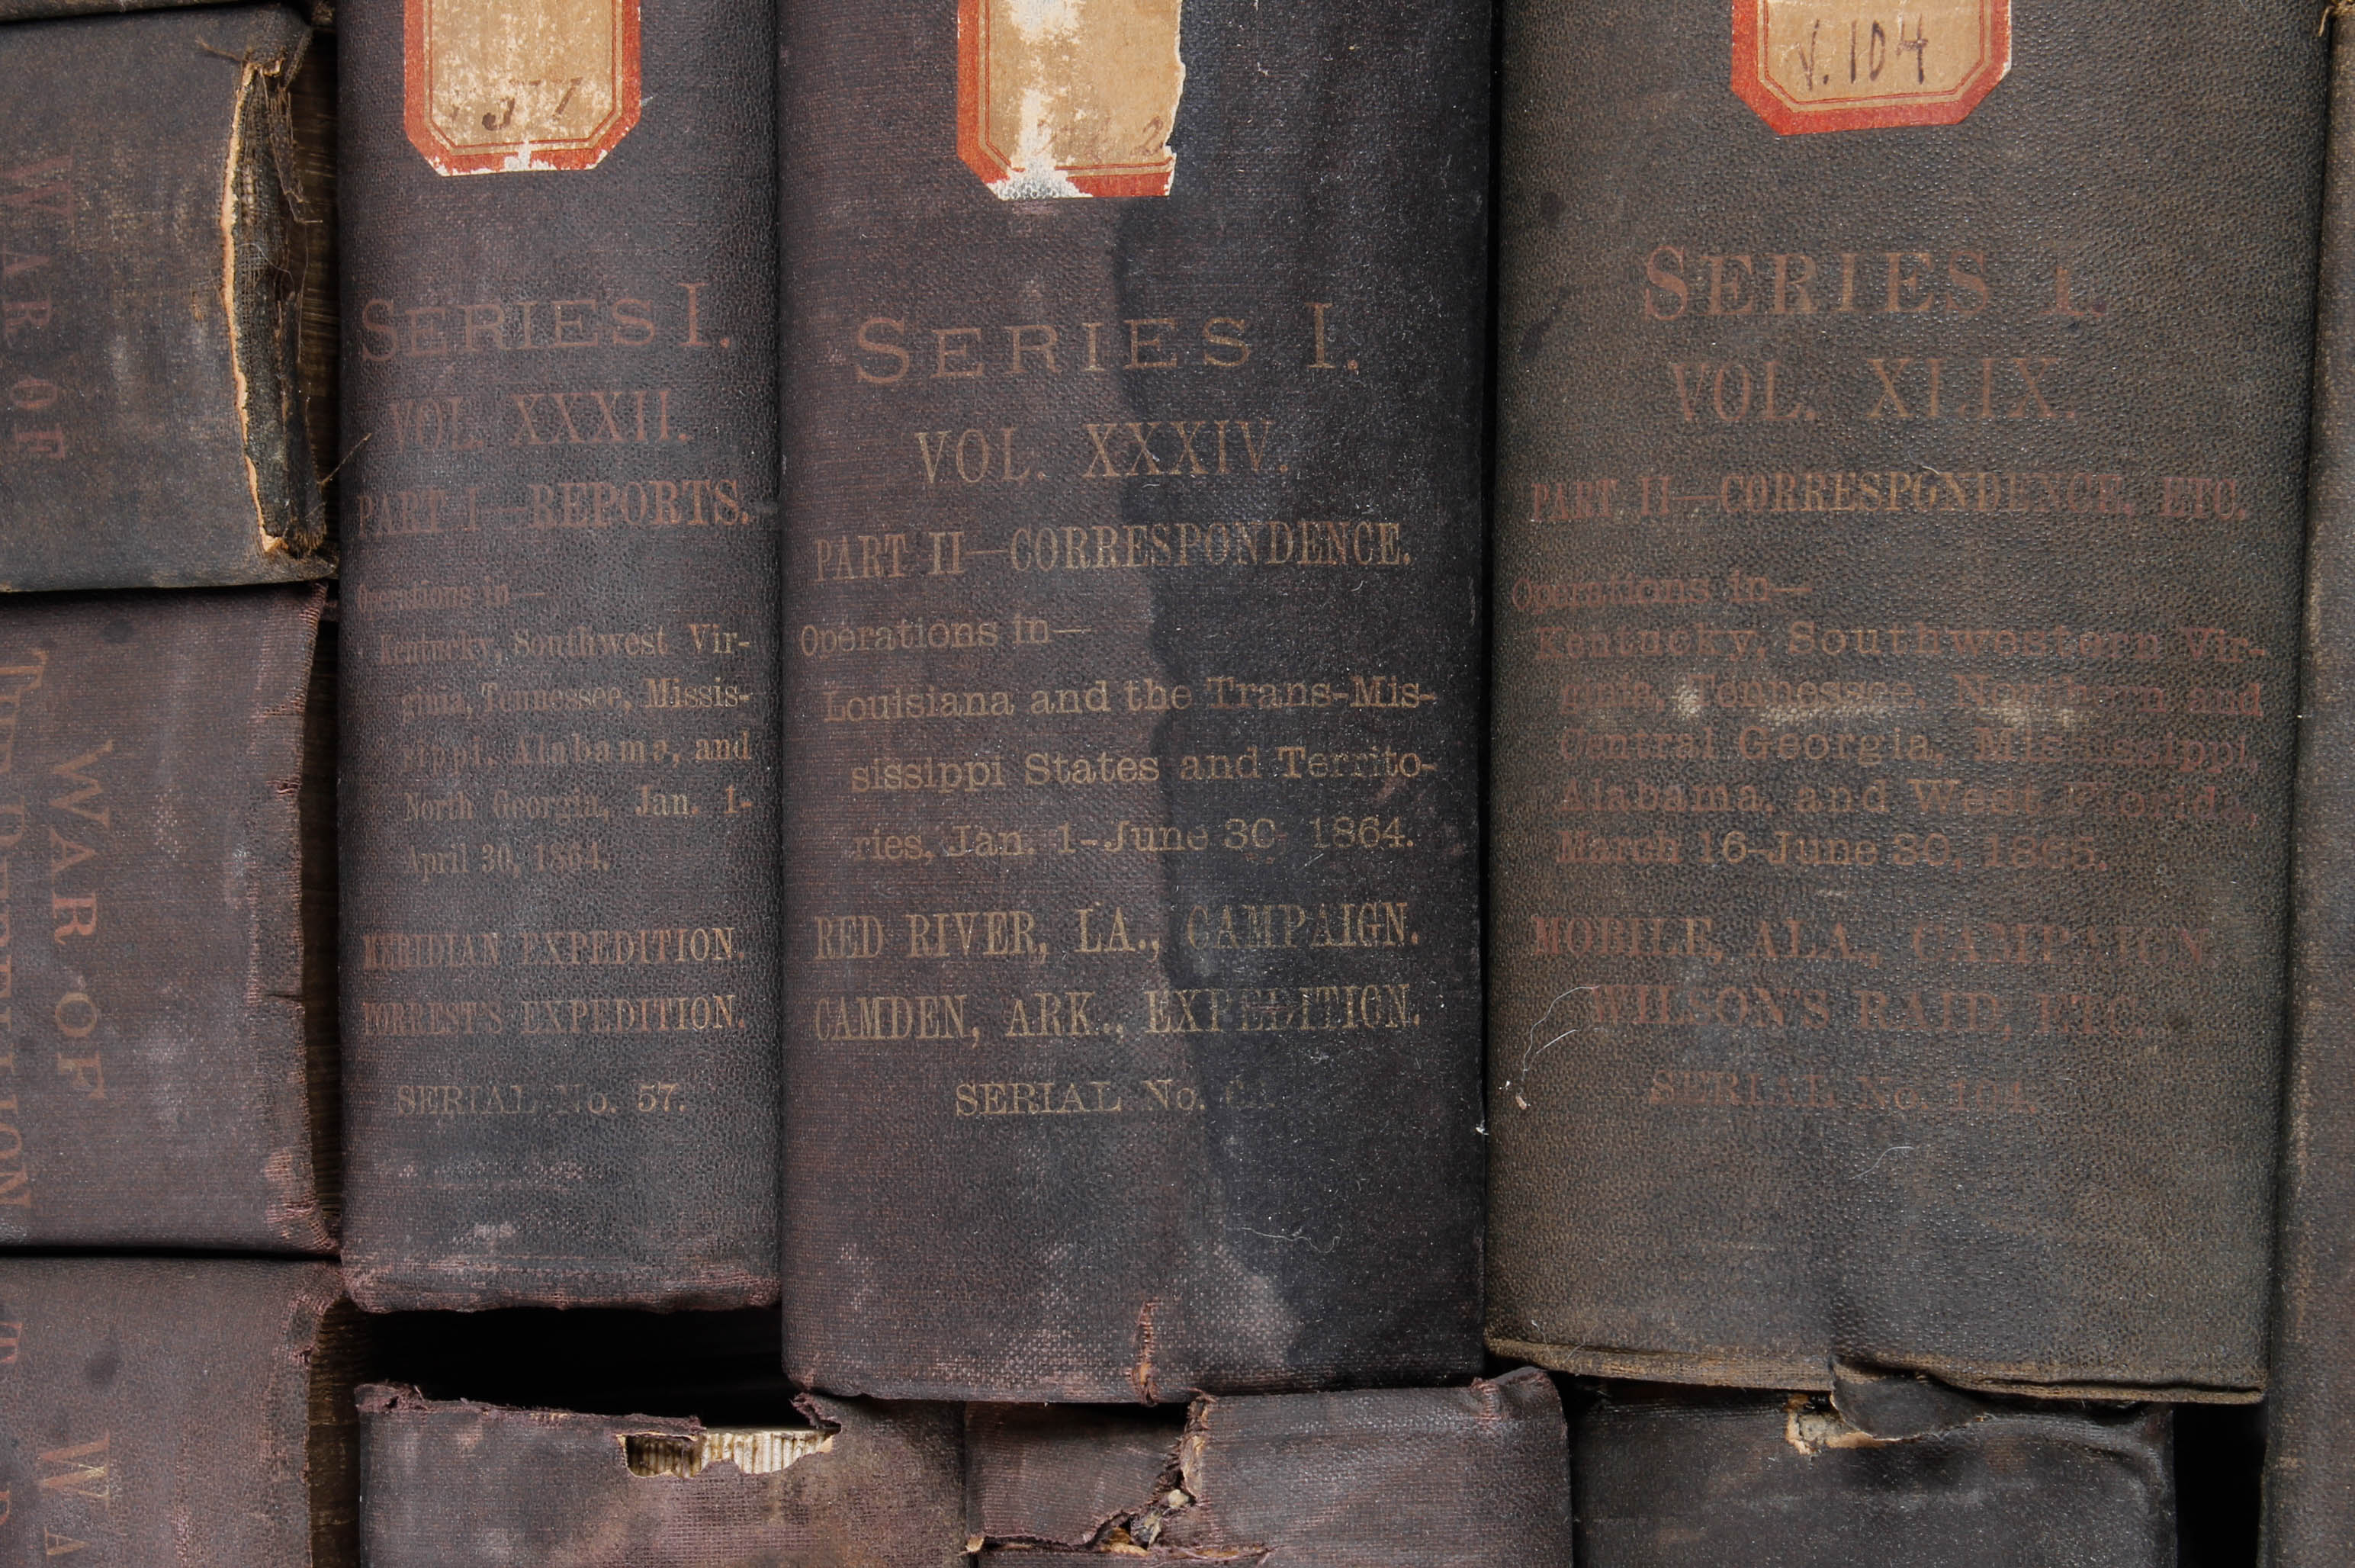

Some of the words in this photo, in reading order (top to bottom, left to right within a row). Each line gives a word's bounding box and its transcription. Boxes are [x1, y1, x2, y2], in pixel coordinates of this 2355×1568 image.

[1645, 245, 1986, 320] SERIES
[361, 298, 656, 362] SERIES
[679, 283, 730, 349] I.
[856, 317, 1251, 383] SERIES
[1306, 302, 1358, 371] I.
[1672, 361, 1817, 421] VOL.
[1866, 358, 2077, 420] XLIX.
[389, 395, 484, 454] VOL.
[507, 390, 692, 446] XXXII.
[917, 427, 1048, 484] VOL.
[1082, 419, 1289, 478] XXXIV.
[357, 488, 448, 536] PART
[1531, 478, 1618, 521] PART
[813, 532, 910, 583] PART
[1512, 572, 1710, 613] Operations
[513, 622, 669, 658] Southwest
[689, 622, 750, 655] Vir-
[801, 616, 999, 658] Operations
[1535, 622, 1766, 663] Kentucky,
[1788, 620, 2160, 660] Southwestern
[2183, 627, 2266, 664] Vir-
[644, 676, 751, 708] Missis-
[824, 686, 1015, 723] Louisiana
[1030, 680, 1111, 715] and
[1127, 677, 1194, 713] the
[1206, 674, 1438, 710] Trans-Mis-
[2187, 682, 2263, 718] and
[695, 730, 752, 762] and
[1560, 726, 1719, 760] Central
[1738, 725, 1945, 766] Georgia,
[851, 756, 1007, 795] sissippi
[1024, 751, 1160, 786] States
[1179, 746, 1261, 781] and
[1277, 744, 1438, 779] Territo-
[403, 790, 474, 822] North
[635, 783, 699, 817] Jan.
[1557, 776, 1775, 818] Alabama,
[1797, 778, 1890, 814] and
[1907, 778, 2043, 816] West
[50, 738, 114, 945] WAR
[406, 842, 468, 882] April
[536, 840, 610, 872] 1864.
[853, 827, 935, 864] ries,
[948, 824, 1036, 857] Jan.
[1312, 815, 1415, 850] 1864.
[1557, 828, 1683, 865] March
[519, 927, 745, 967] EXPEDITION.
[814, 915, 885, 961] RED
[906, 910, 1048, 964] RIVER,
[1074, 904, 1161, 962] LA.,
[1187, 901, 1420, 951] CAMPAIGN.
[1532, 914, 1724, 966] MOBILE,
[519, 994, 745, 1035] EXPEDITION.
[815, 994, 982, 1049] CAMDEN,
[1144, 983, 1421, 1034] EXPEDITION.
[1589, 985, 1830, 1030] WILSON'S
[1854, 991, 2013, 1042] RAID,
[53, 991, 107, 1100] OF
[397, 1083, 533, 1116] SERIAL
[554, 1081, 617, 1115] No.
[638, 1081, 686, 1113] 57.
[955, 1080, 1122, 1117] SERIAL
[1143, 1078, 1206, 1112] No.
[1854, 1074, 1929, 1111] No.
